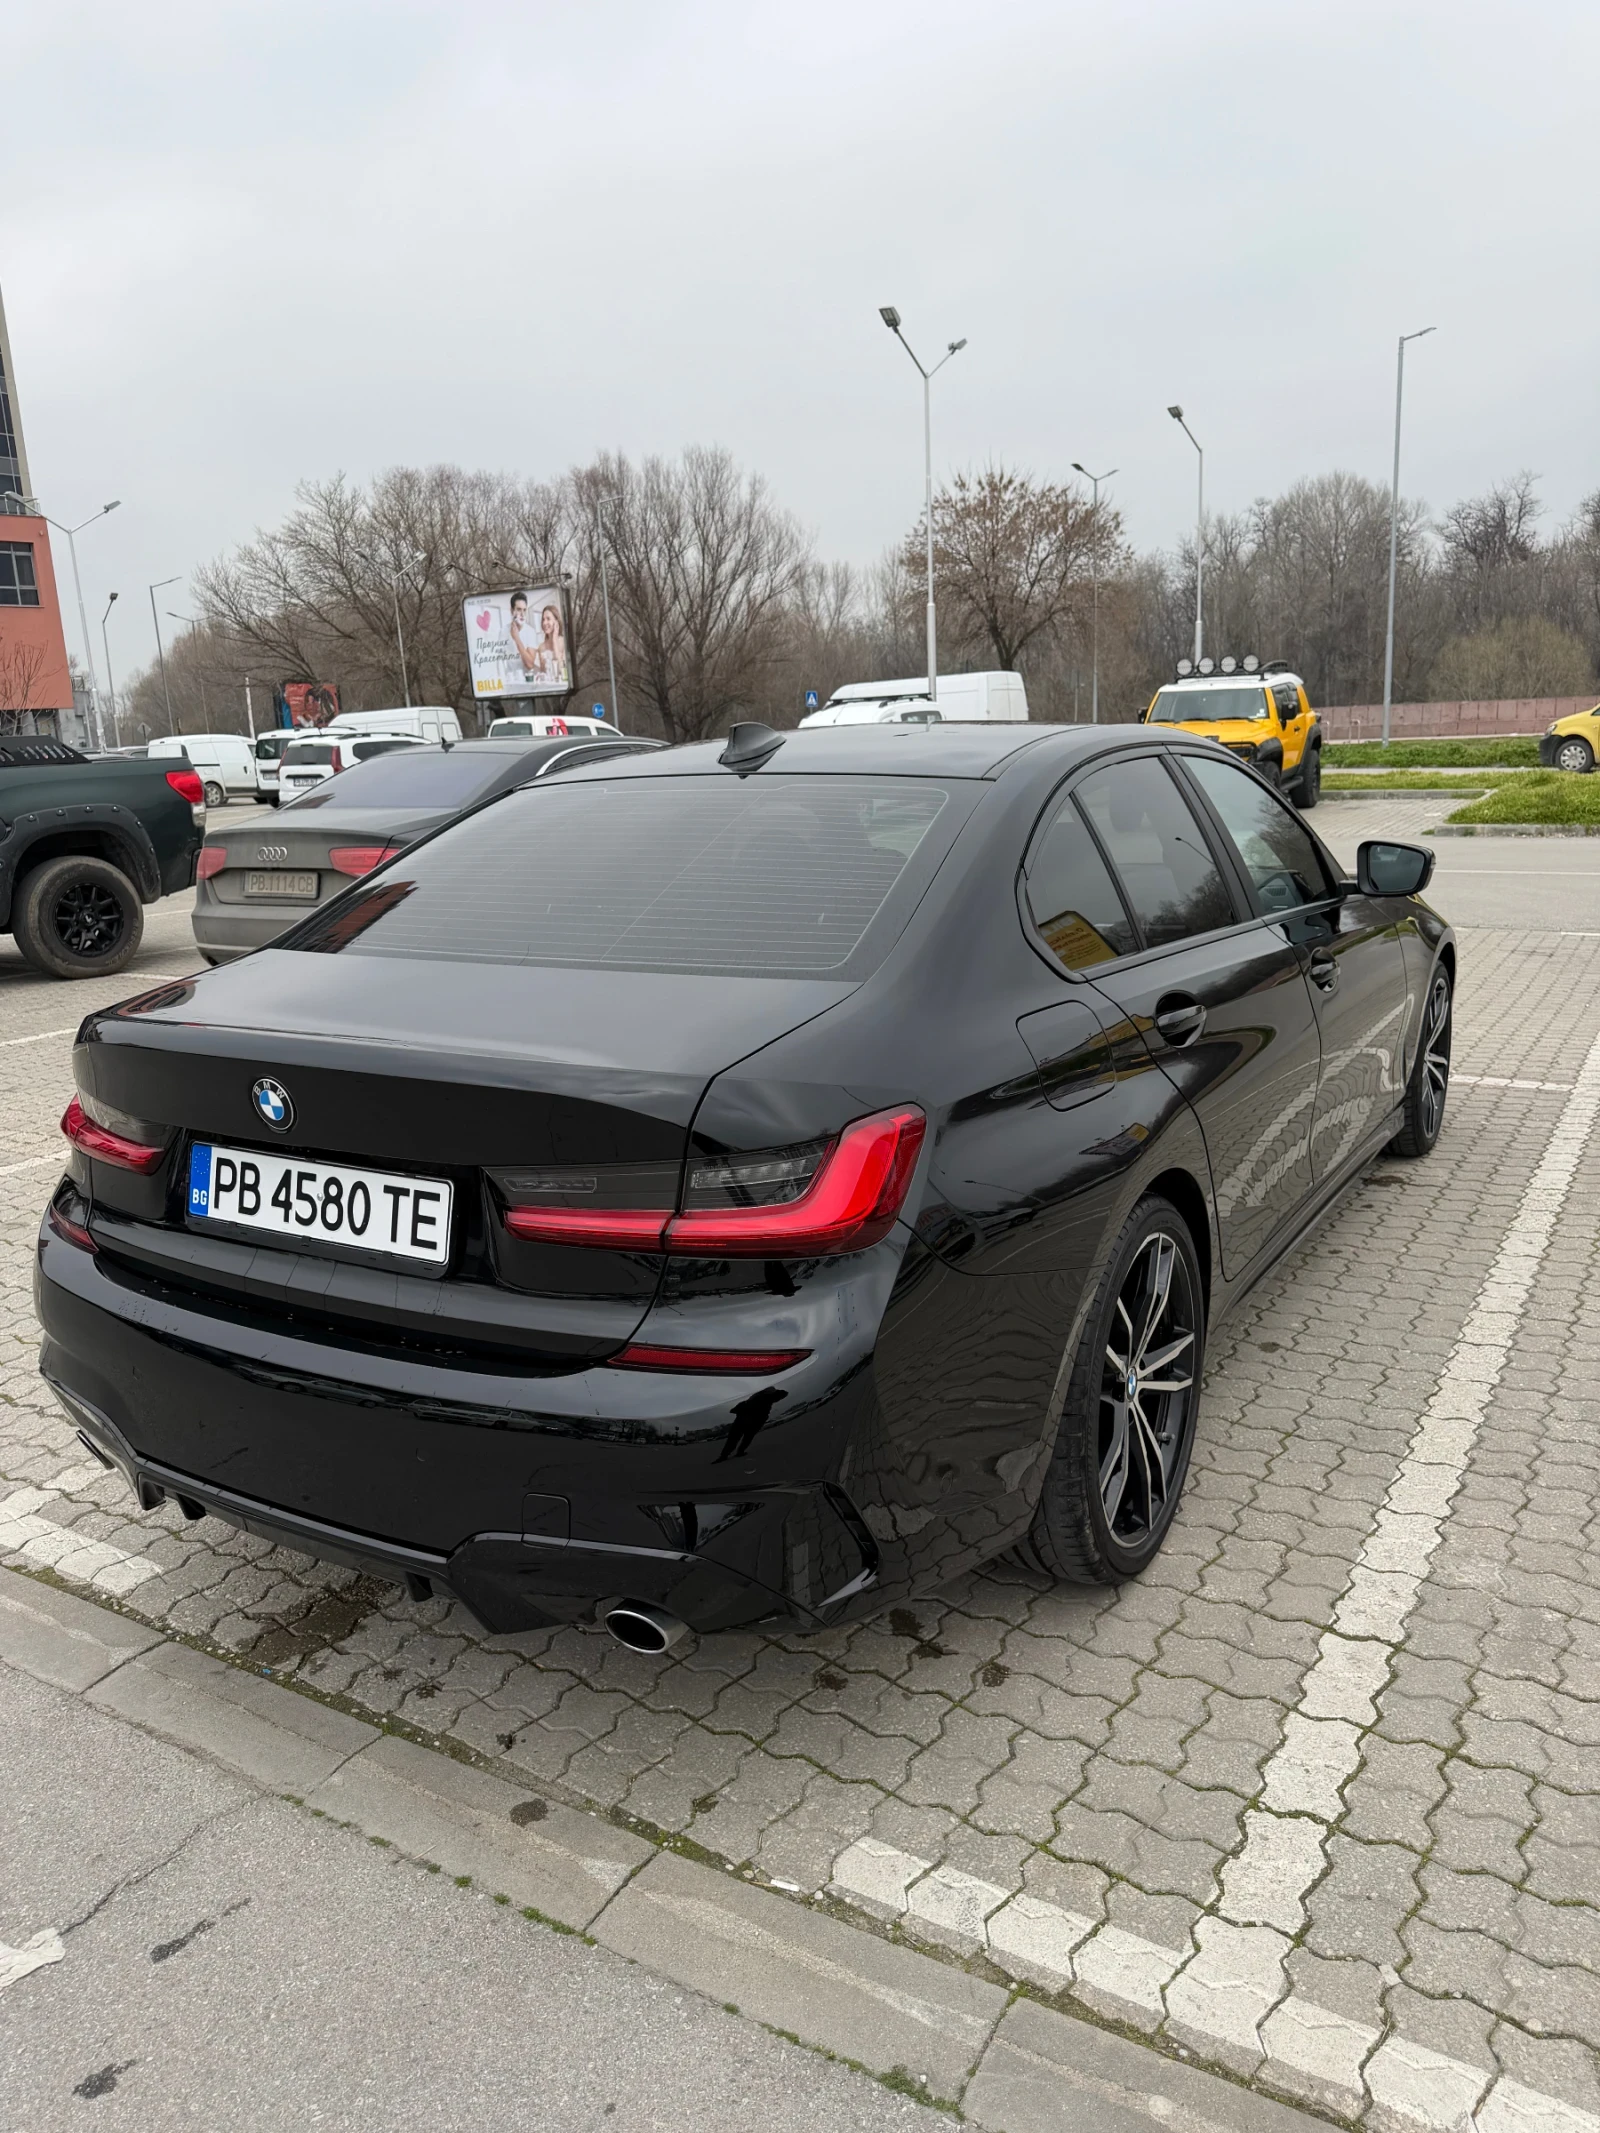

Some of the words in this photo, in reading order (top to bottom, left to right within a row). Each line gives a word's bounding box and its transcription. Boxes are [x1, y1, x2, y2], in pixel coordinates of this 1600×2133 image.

[476, 679, 504, 693] BILLA
[253, 1080, 286, 1099] BMW
[192, 1188, 208, 1206] BG
[213, 1157, 261, 1215] PB
[270, 1168, 371, 1236] 4580
[382, 1184, 441, 1250] TE
